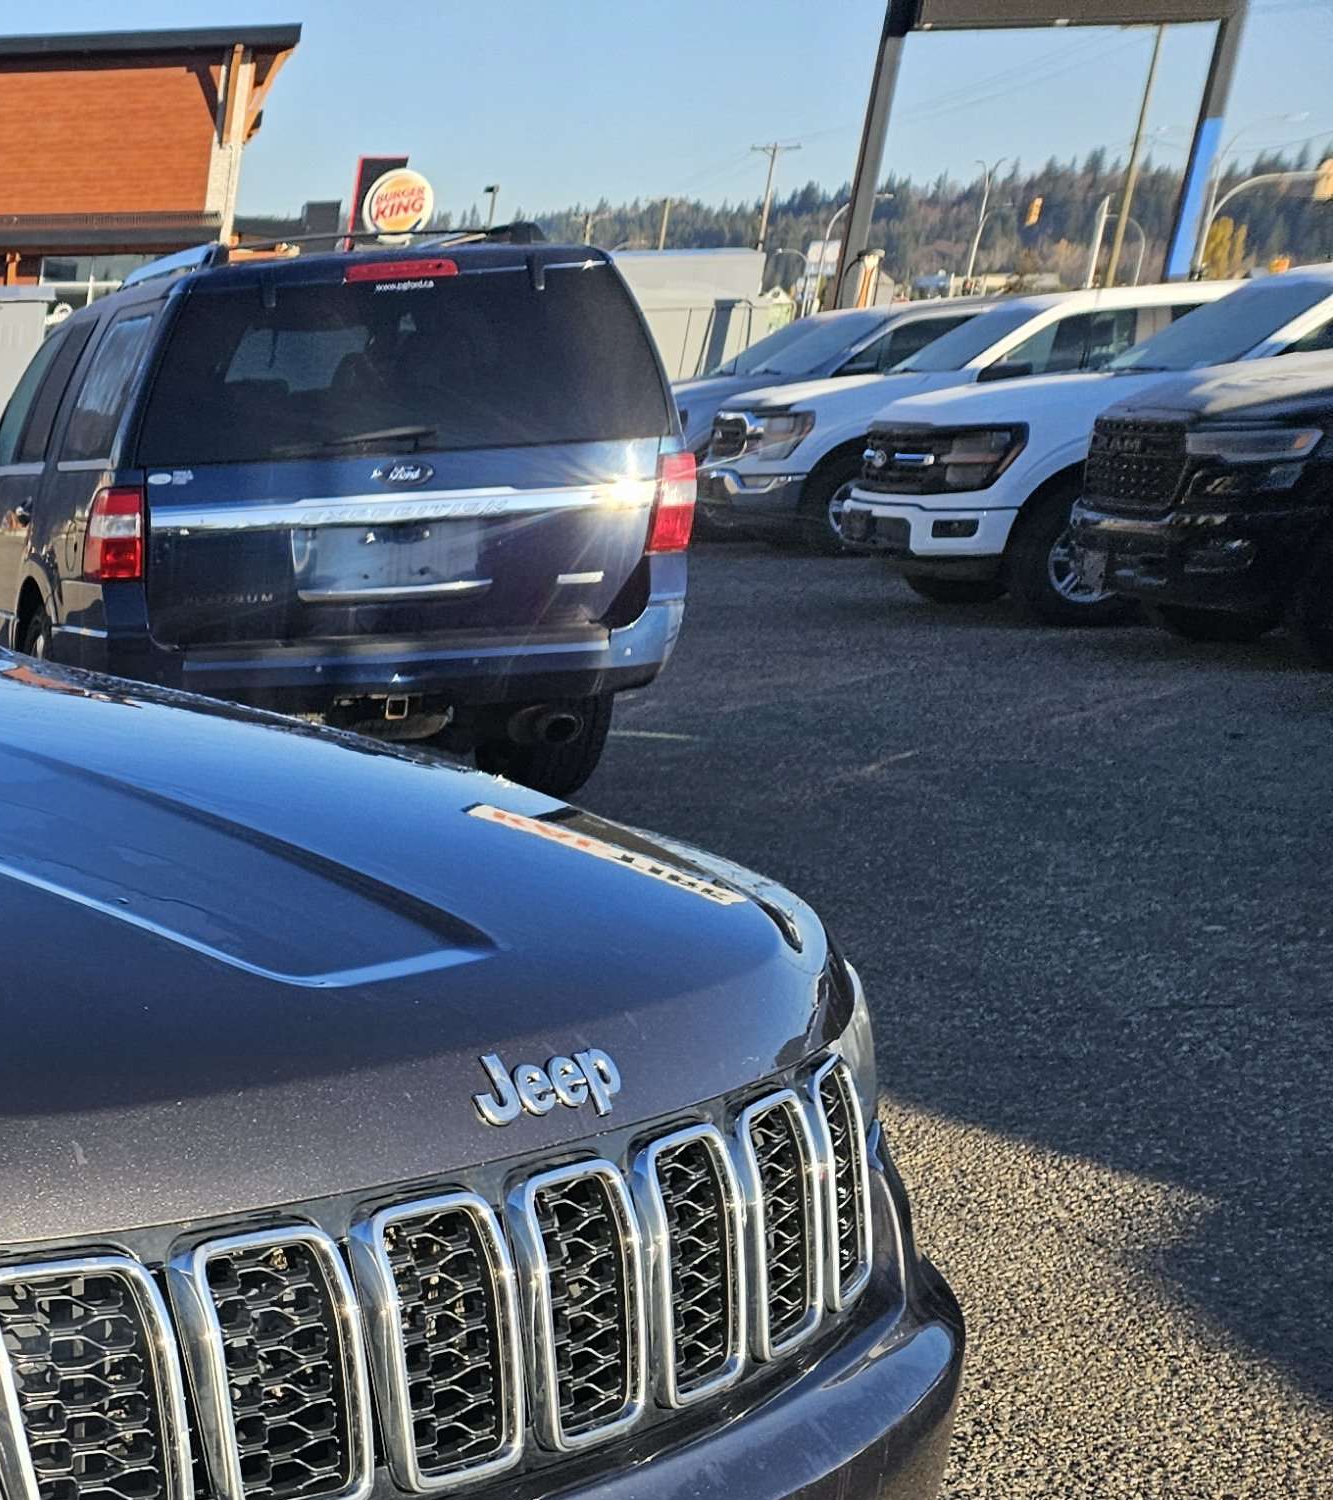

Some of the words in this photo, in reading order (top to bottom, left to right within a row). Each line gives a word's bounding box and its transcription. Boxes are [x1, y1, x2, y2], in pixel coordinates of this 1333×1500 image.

[375, 185, 426, 204] BURGER
[374, 198, 425, 223] KING
[388, 465, 423, 481] Ford
[472, 1048, 622, 1127] Jeep
